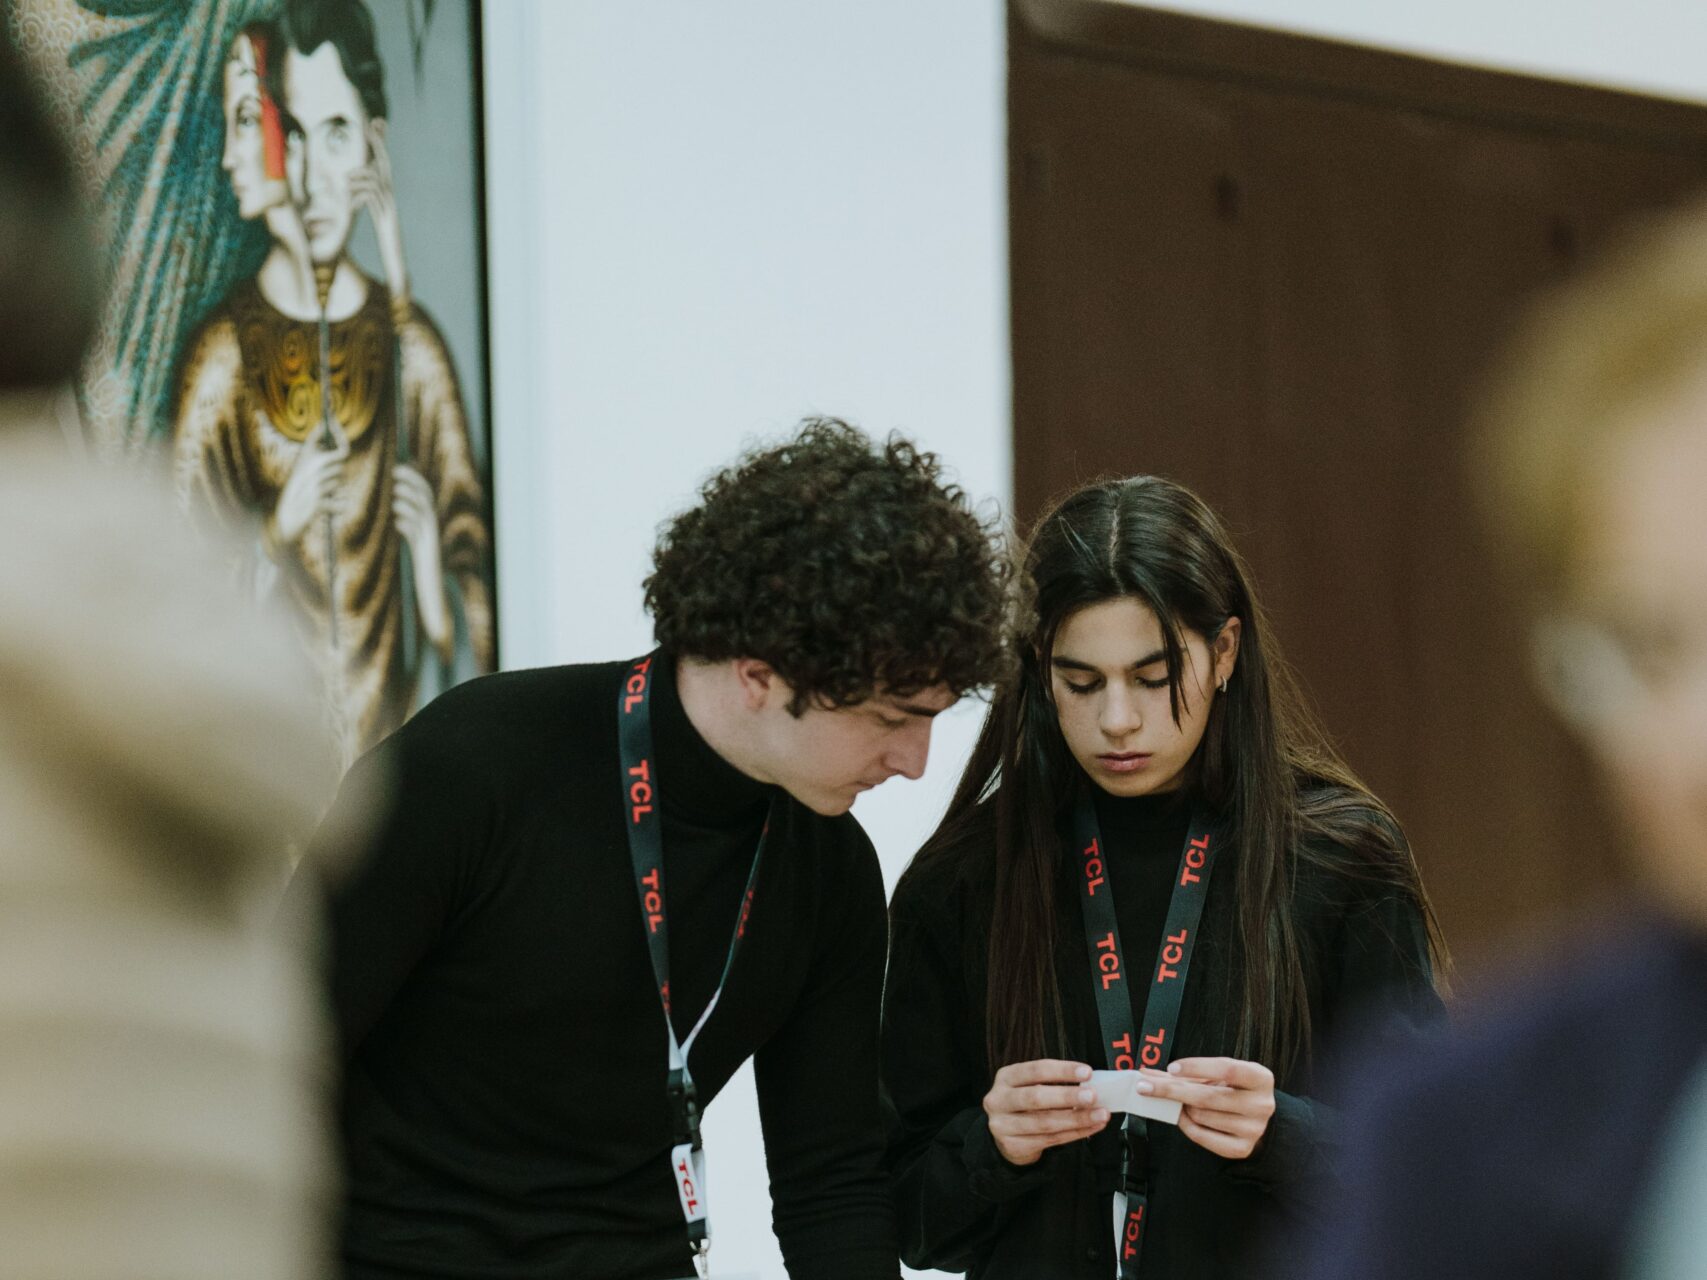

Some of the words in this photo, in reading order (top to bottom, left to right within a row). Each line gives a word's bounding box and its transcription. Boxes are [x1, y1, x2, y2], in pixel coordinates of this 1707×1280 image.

[624, 657, 652, 713] TCL
[628, 758, 654, 824] TCL
[1083, 837, 1105, 896] TCL
[1180, 833, 1211, 887] TCL
[641, 868, 664, 933] TCL
[1096, 931, 1121, 990] TCL
[1157, 928, 1188, 983] TCL
[1111, 1032, 1135, 1070] TC
[1140, 1027, 1166, 1070] CL
[678, 1158, 698, 1215] TCL
[1123, 1205, 1144, 1261] TCL
